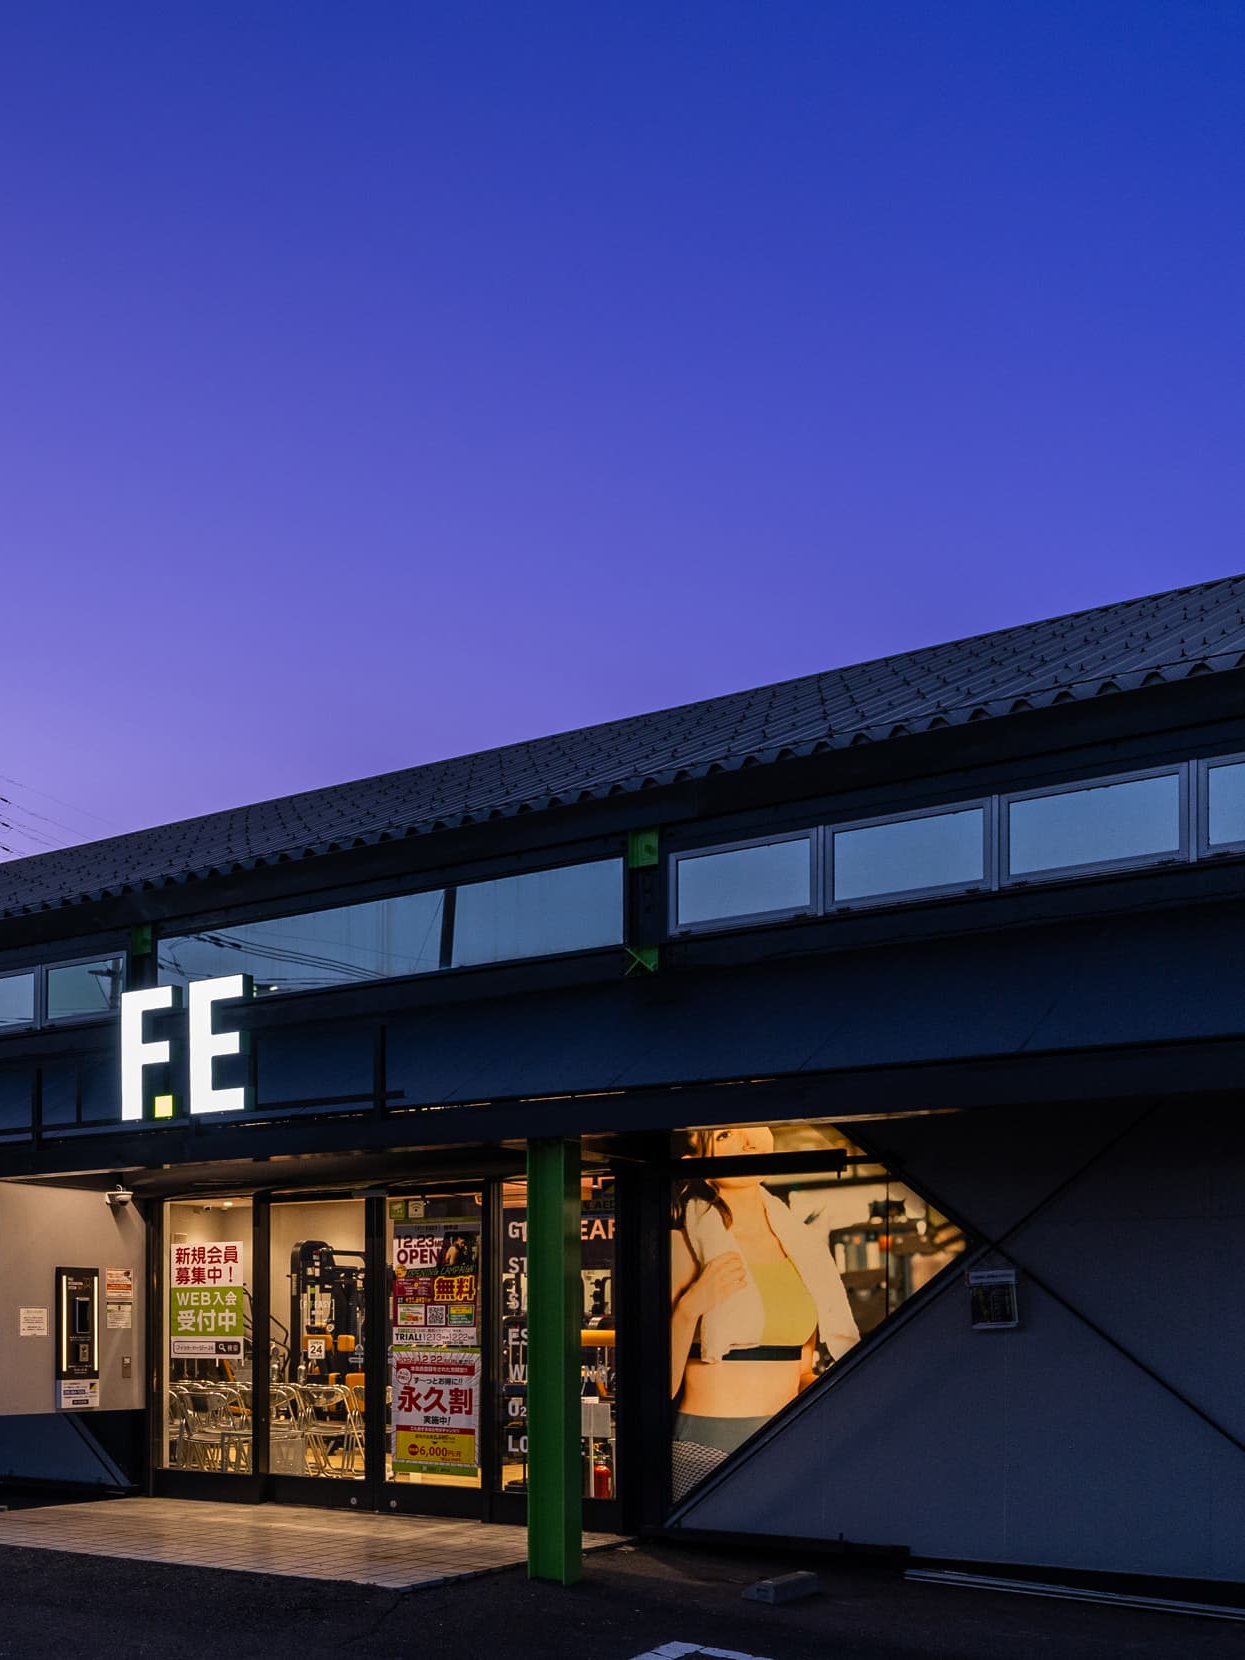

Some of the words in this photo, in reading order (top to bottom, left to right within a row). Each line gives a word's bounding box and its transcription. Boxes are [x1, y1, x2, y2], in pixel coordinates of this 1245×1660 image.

[175, 1245, 239, 1265] 新規会員
[397, 1248, 440, 1264] OPEN
[176, 1291, 238, 1306] WEB入会
[434, 1275, 476, 1302] 無料
[177, 1309, 237, 1333] 受付中
[310, 1345, 323, 1354] 24
[398, 1385, 474, 1416] 永久割
